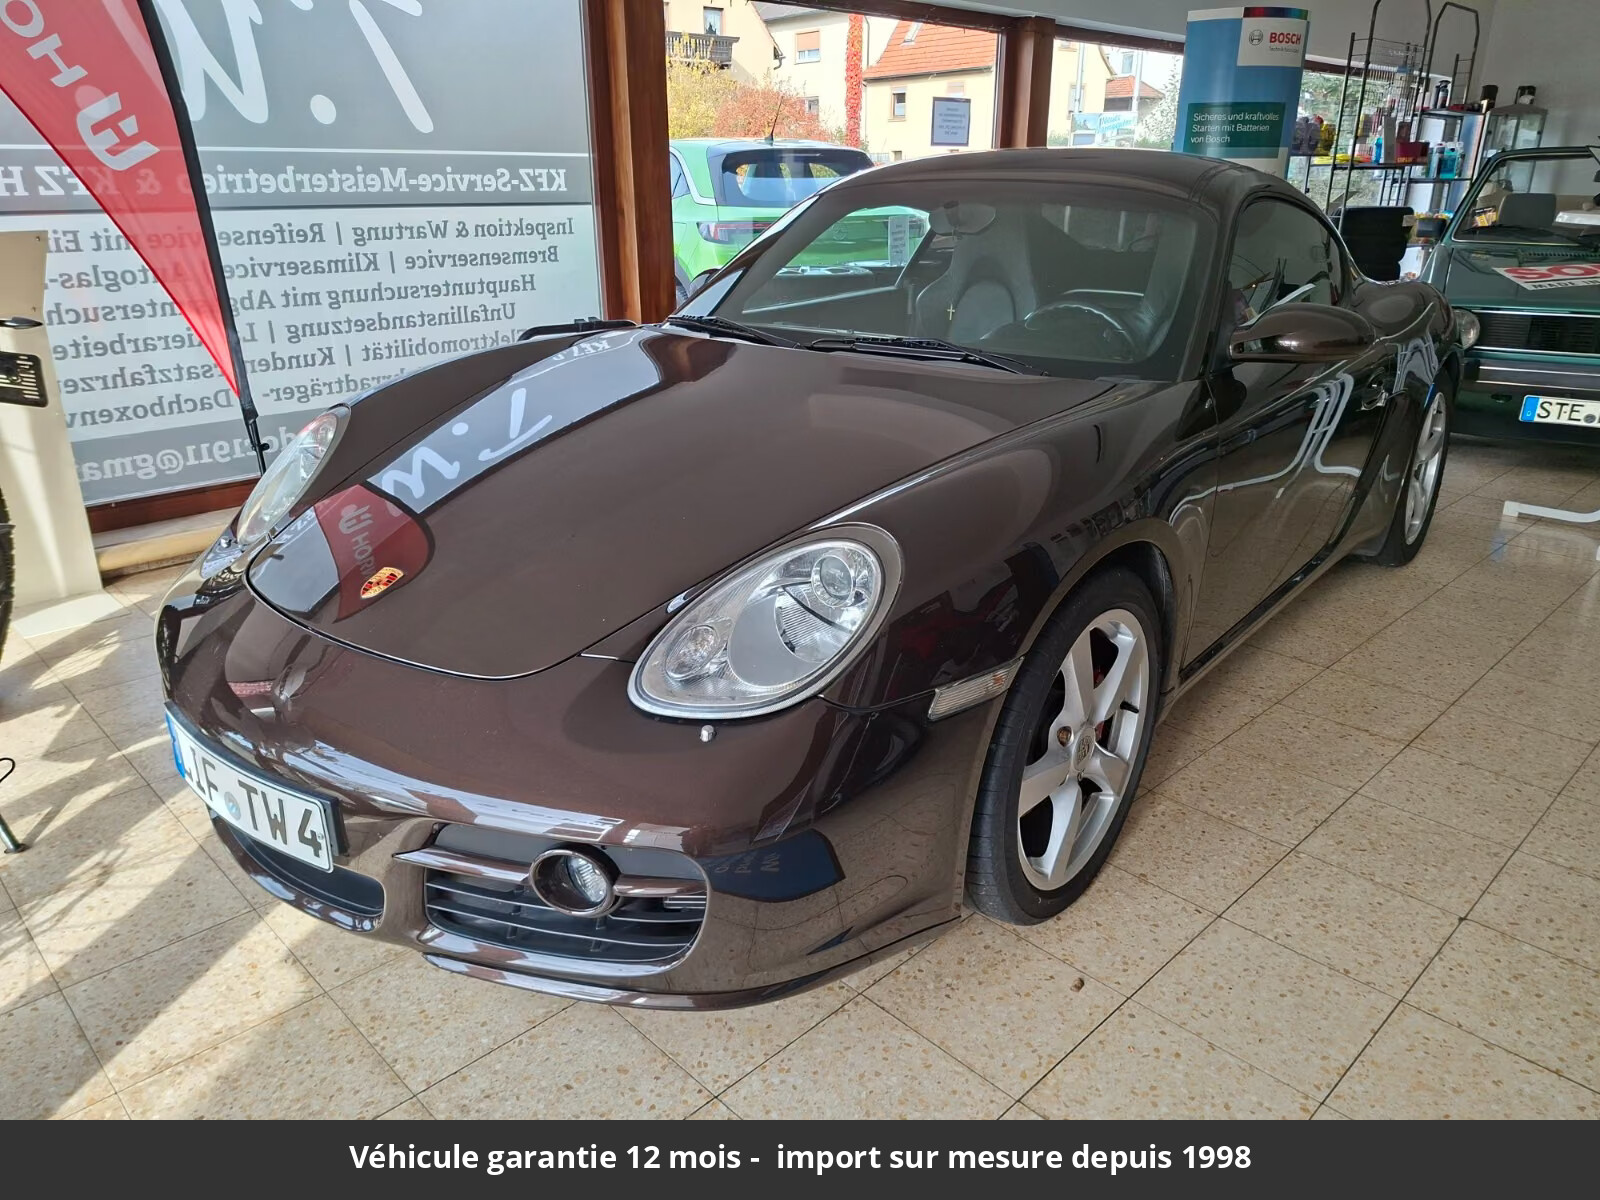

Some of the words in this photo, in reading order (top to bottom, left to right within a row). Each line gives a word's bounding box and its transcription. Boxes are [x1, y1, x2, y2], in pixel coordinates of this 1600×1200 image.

[1269, 32, 1301, 45] BOSCH
[1193, 112, 1226, 121] Sicheres
[1228, 112, 1243, 120] und
[1245, 111, 1279, 120] kraftvolles
[1192, 124, 1220, 132] Starten
[1221, 124, 1235, 132] mit
[1236, 123, 1270, 132] Batterien
[1205, 134, 1230, 143] Bosch
[1504, 264, 1600, 280] SO
[1532, 280, 1576, 290] MADE
[1536, 400, 1585, 422] STE
[238, 779, 287, 846] TW
[297, 808, 323, 858] 4
